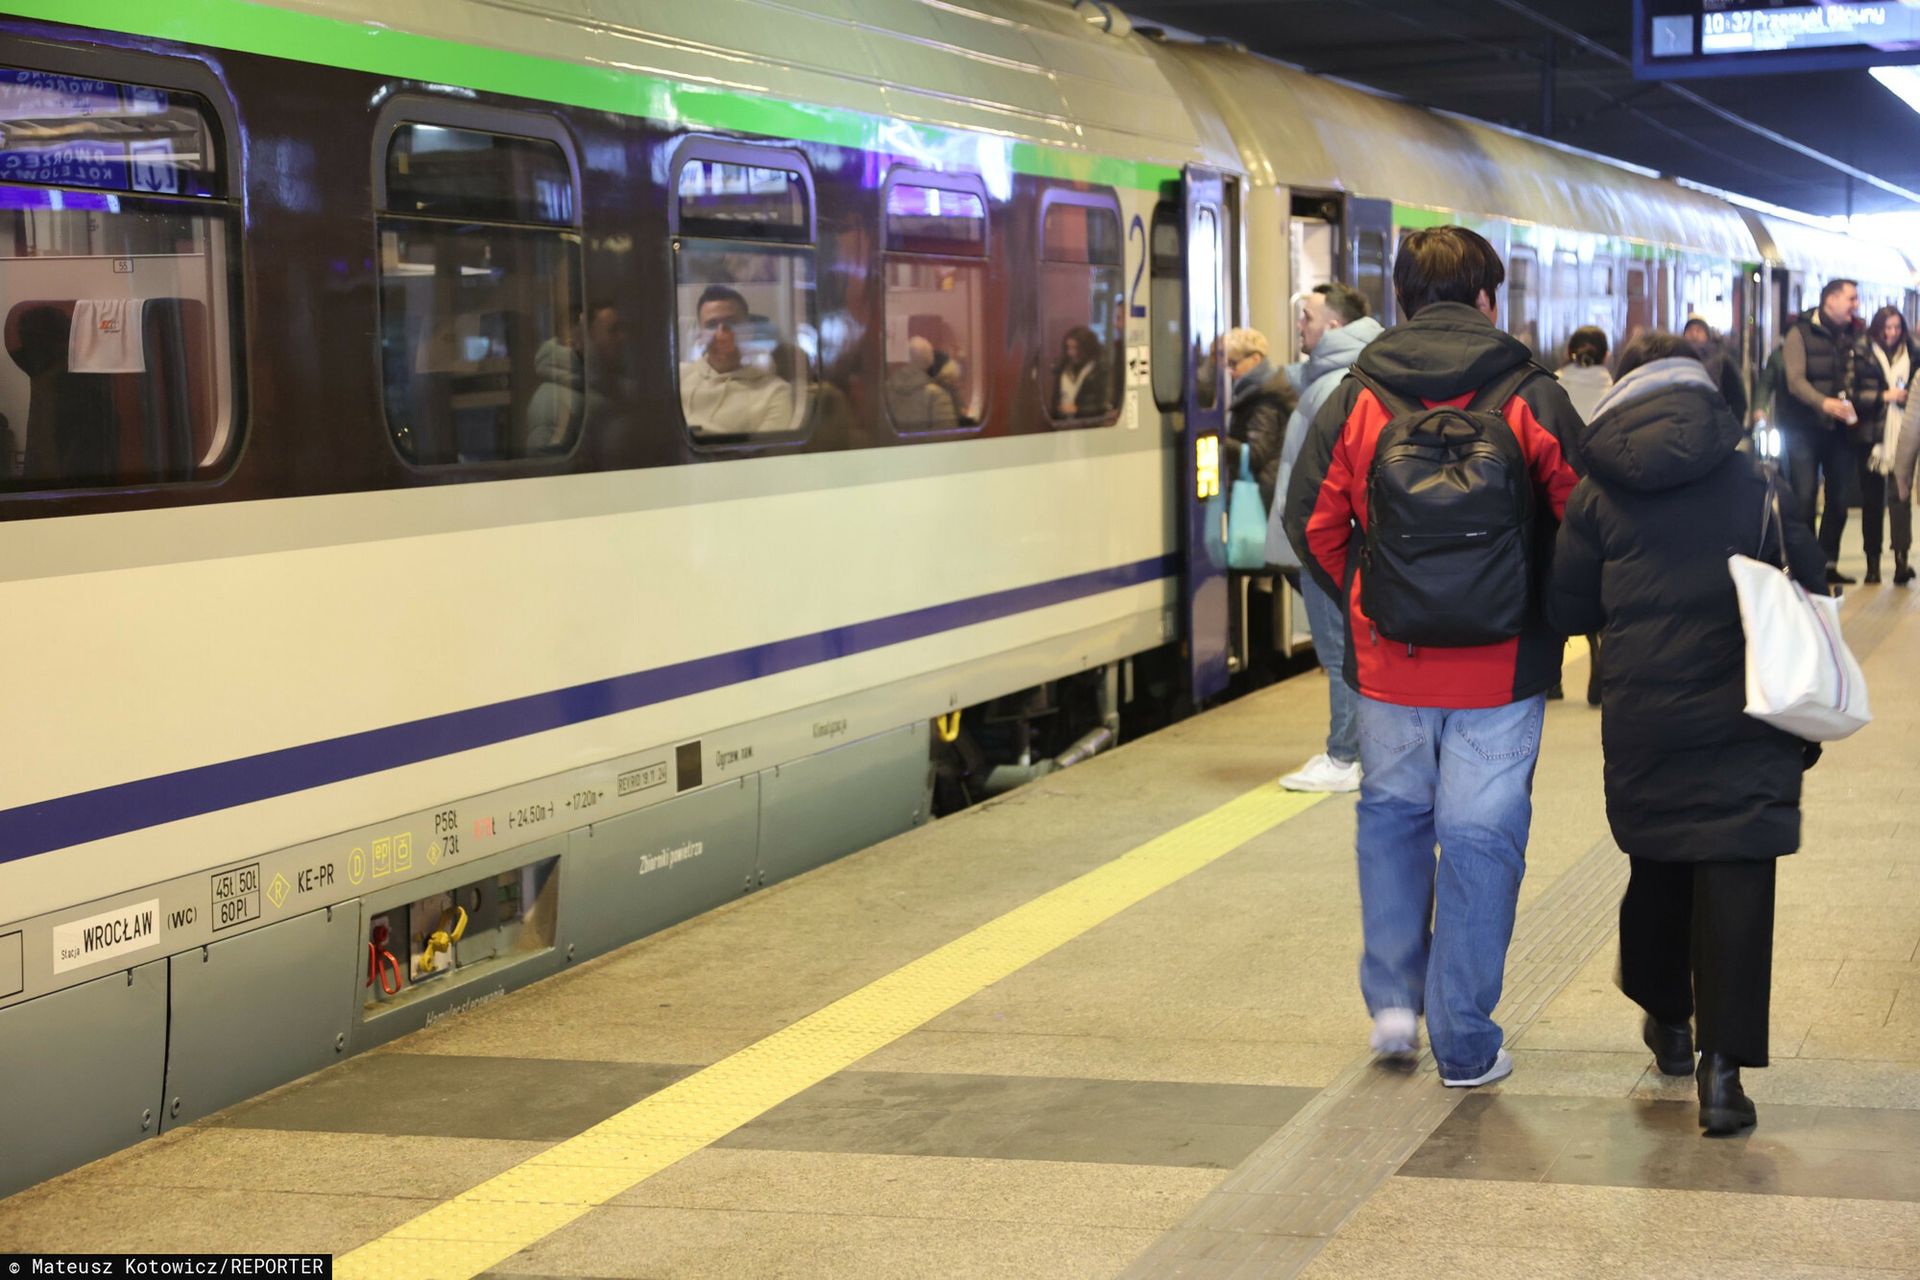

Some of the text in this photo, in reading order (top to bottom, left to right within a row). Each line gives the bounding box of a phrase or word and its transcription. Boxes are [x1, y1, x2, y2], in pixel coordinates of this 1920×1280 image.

[1129, 213, 1147, 318] 2
[442, 835, 459, 857] 73t
[216, 870, 257, 899] 45t 50t
[297, 862, 335, 894] KE-PR
[166, 907, 198, 931] (WC)
[61, 911, 153, 960] Stacja WROCŁAW
